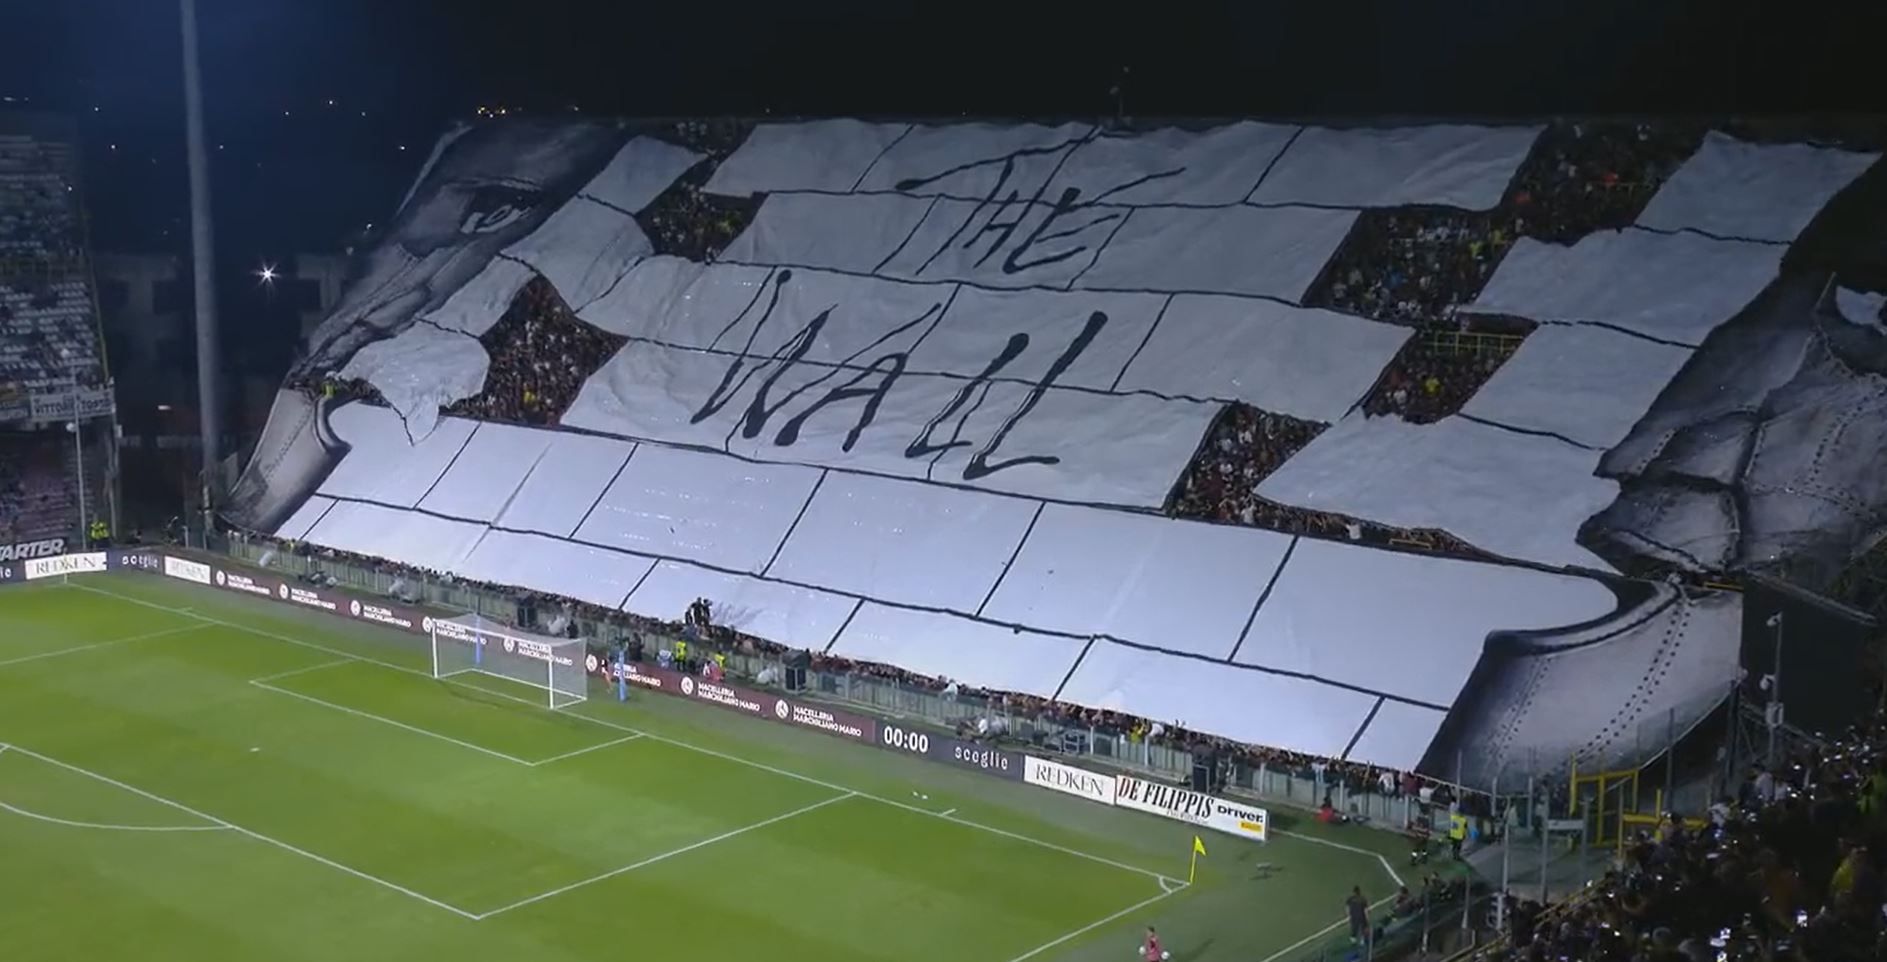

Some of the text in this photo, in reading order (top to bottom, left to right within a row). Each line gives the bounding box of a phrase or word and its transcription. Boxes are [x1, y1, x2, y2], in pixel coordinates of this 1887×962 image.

[896, 128, 1187, 275] THE
[690, 269, 1108, 480] WALL
[739, 699, 761, 712] MARIO
[793, 705, 834, 721] MACELLERIA
[839, 724, 862, 737] MARIO
[883, 725, 929, 753] 00:00
[1034, 763, 1104, 796] REDKEN
[1118, 776, 1141, 801] DE
[1142, 783, 1215, 819] FILIPPIS
